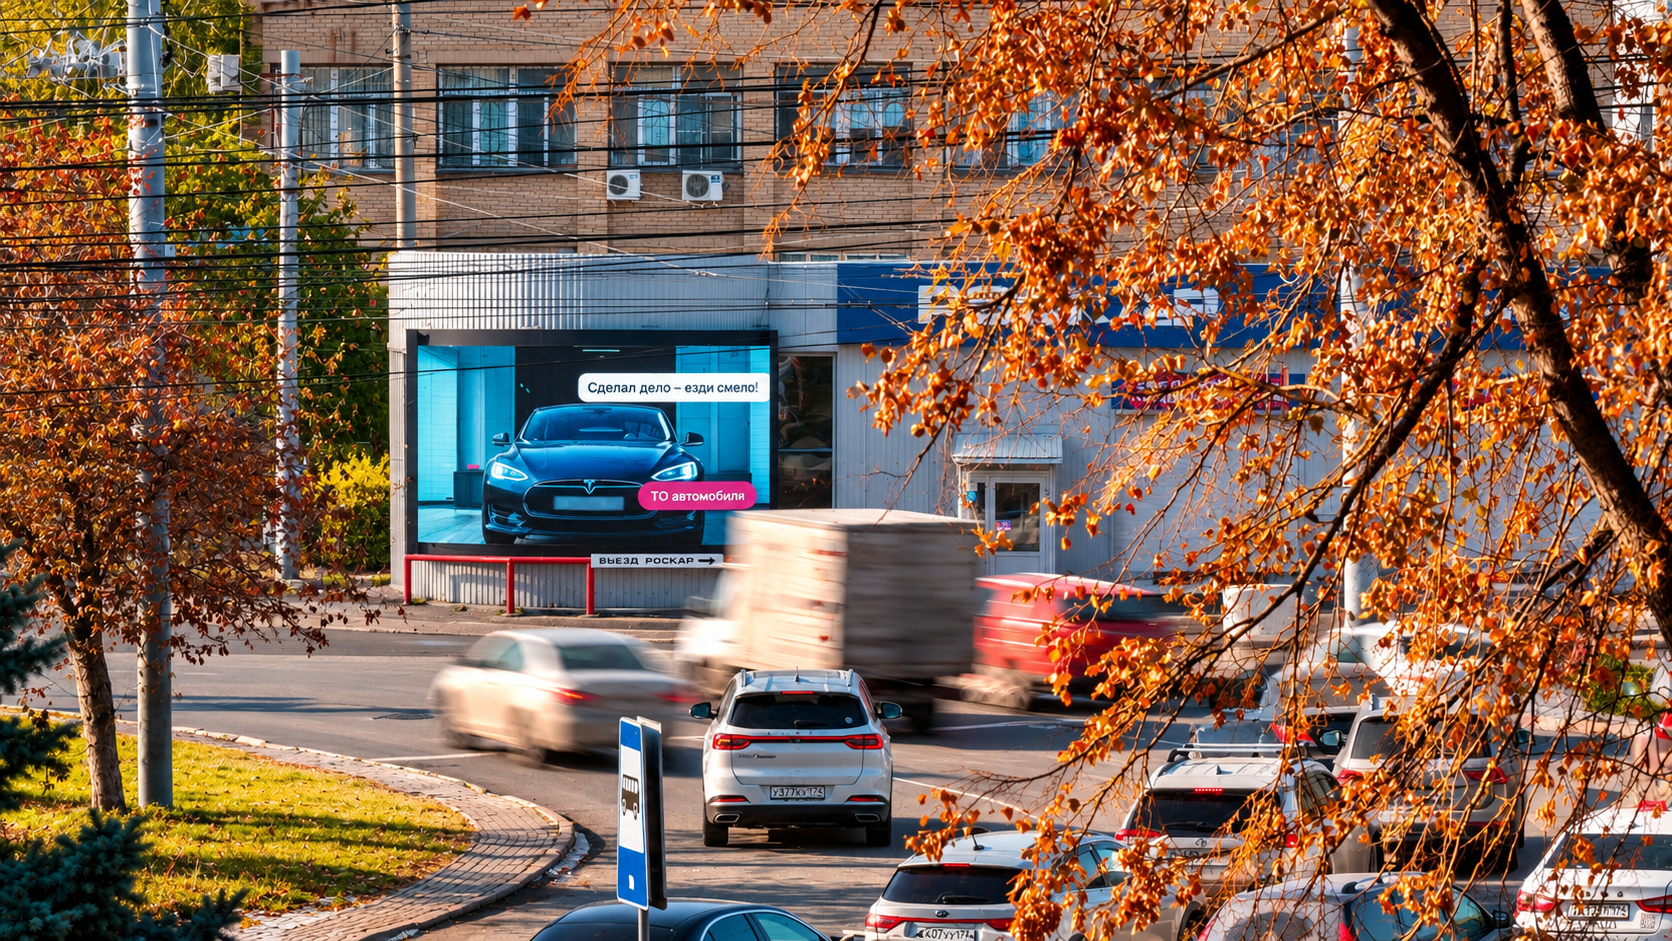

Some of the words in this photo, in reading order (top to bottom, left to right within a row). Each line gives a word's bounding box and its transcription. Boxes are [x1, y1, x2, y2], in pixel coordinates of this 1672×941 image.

[918, 285, 1219, 327] РОР
[588, 382, 636, 395] Сделал
[639, 383, 671, 395] дело
[684, 384, 714, 395] езди
[717, 382, 759, 394] смело!
[650, 491, 669, 502] ТО
[672, 490, 745, 502] автомобиля
[599, 557, 639, 566] ВЫЕЗД
[645, 557, 694, 565] РОСКАР
